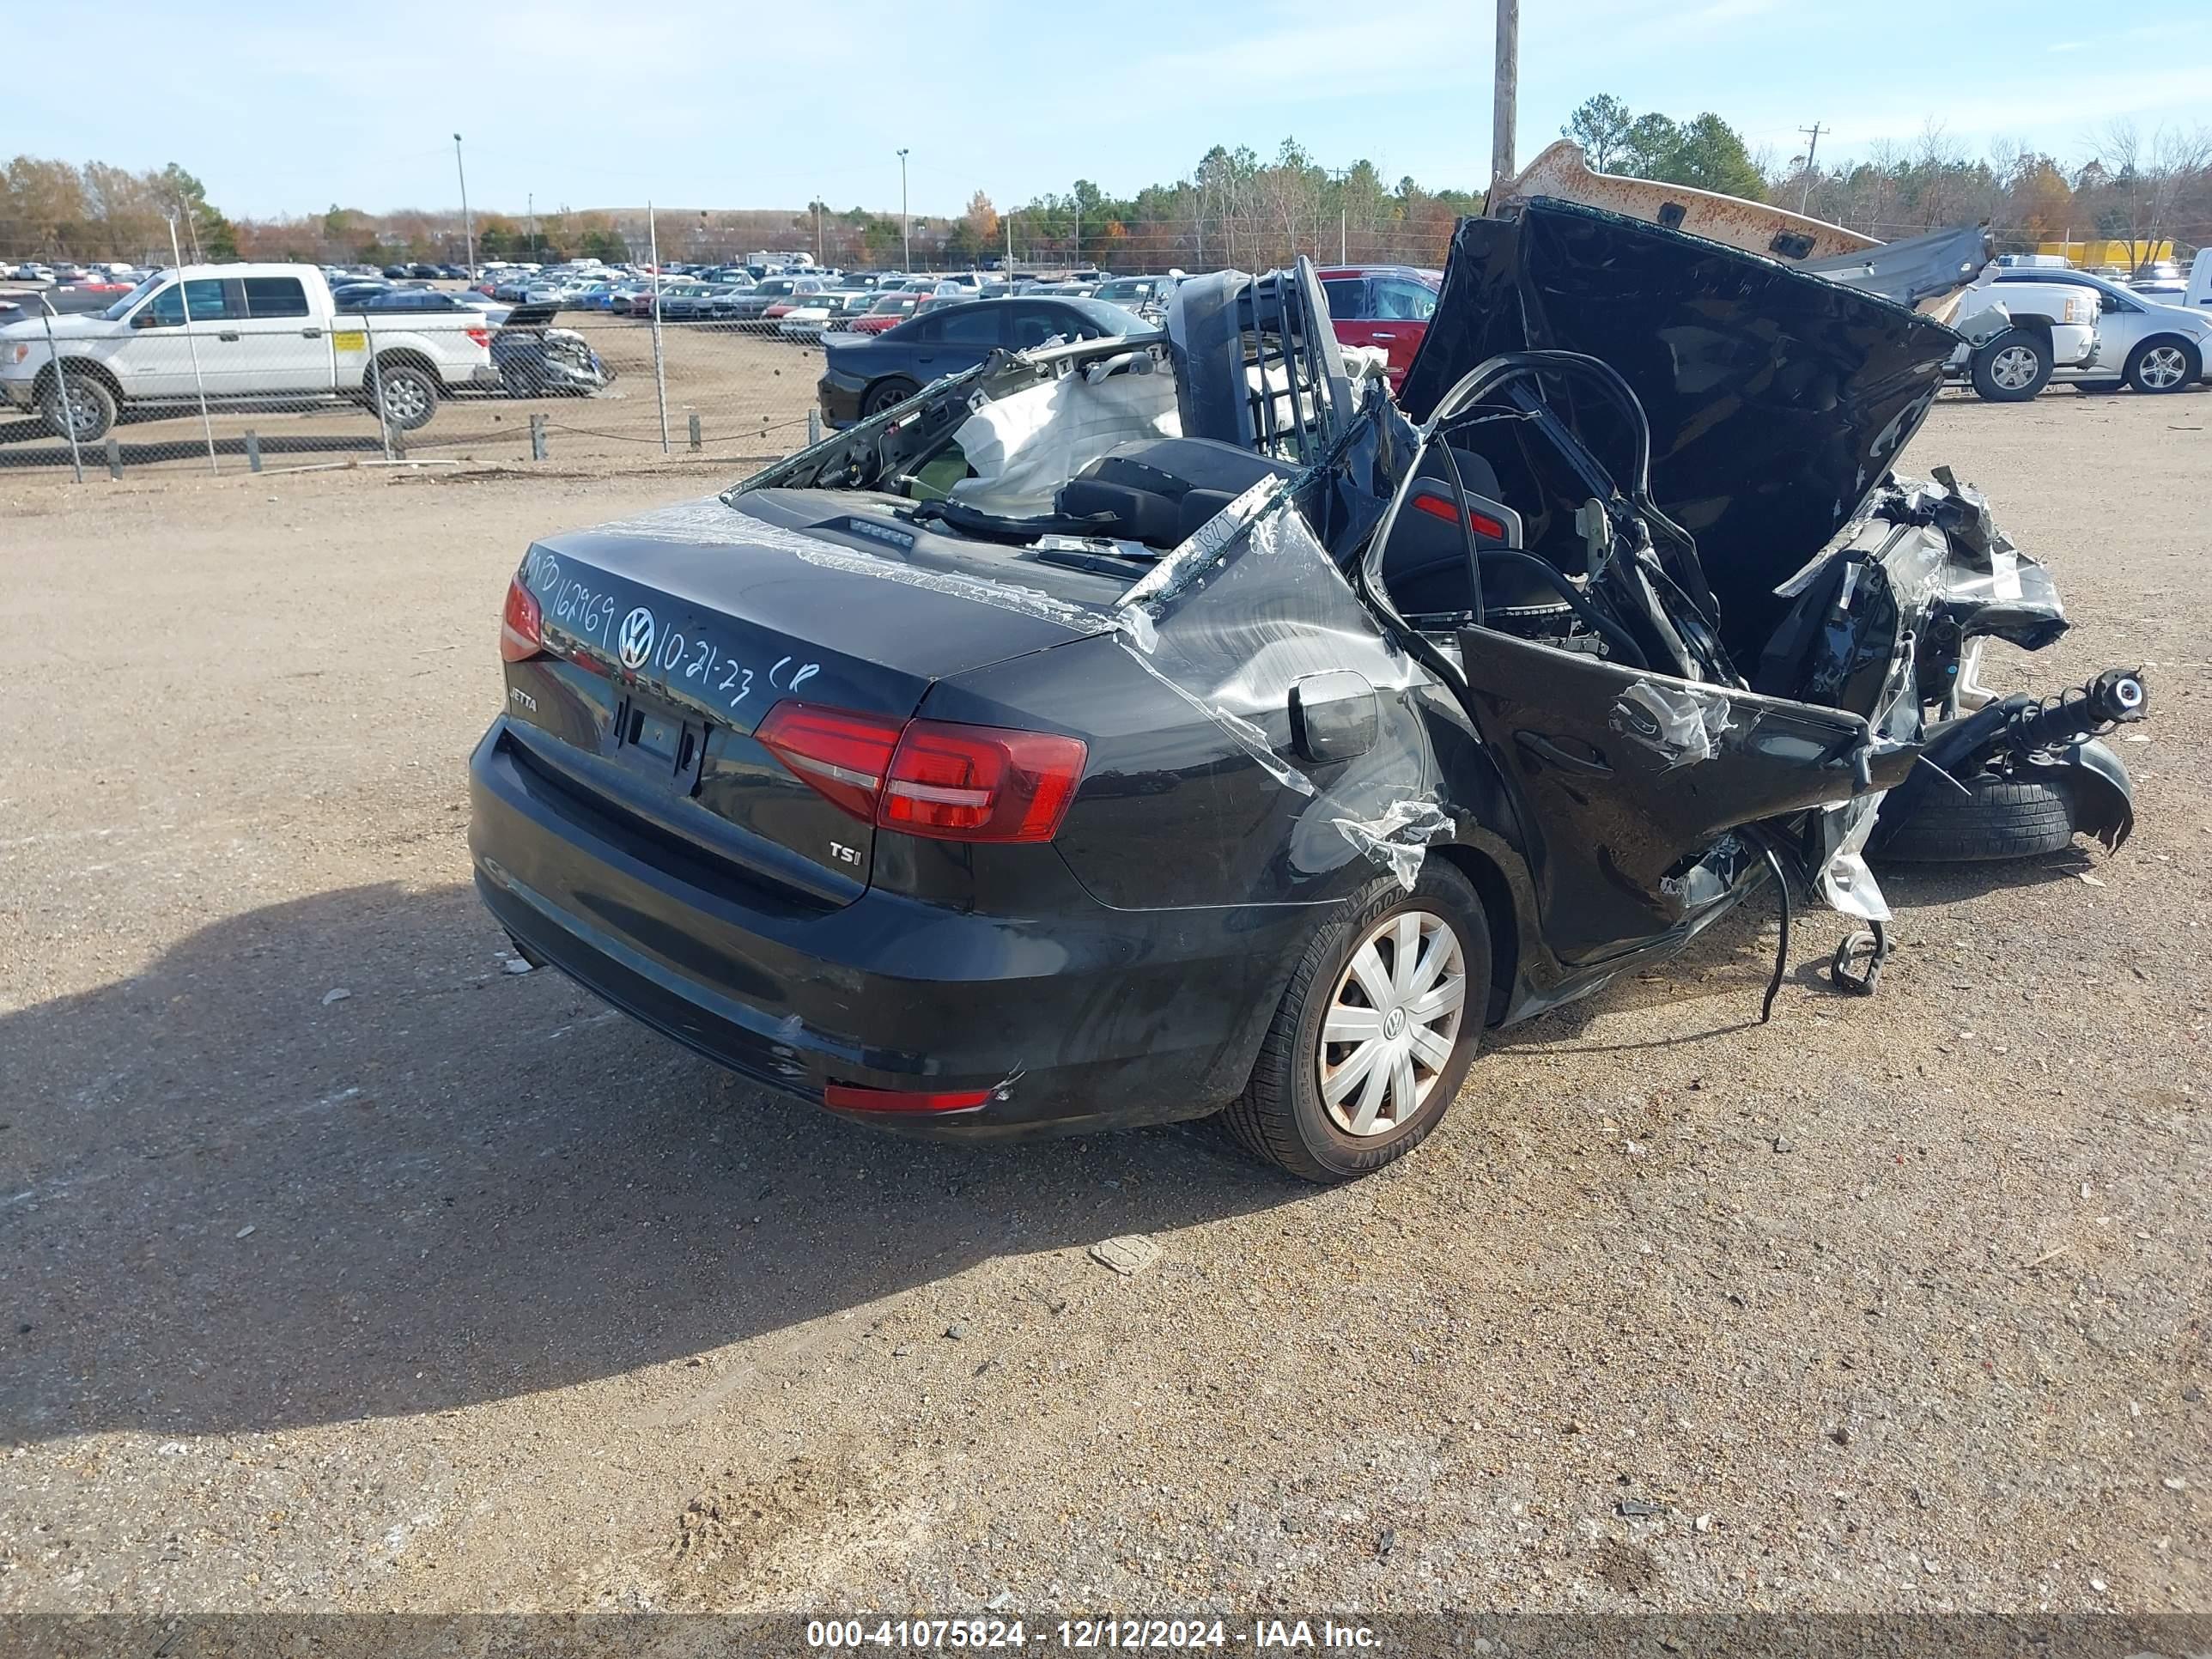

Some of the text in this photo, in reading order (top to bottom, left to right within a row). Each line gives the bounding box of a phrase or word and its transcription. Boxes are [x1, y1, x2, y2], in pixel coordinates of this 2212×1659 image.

[550, 578, 615, 650] 162969
[509, 686, 538, 712] JETTA
[829, 841, 862, 866] TSI
